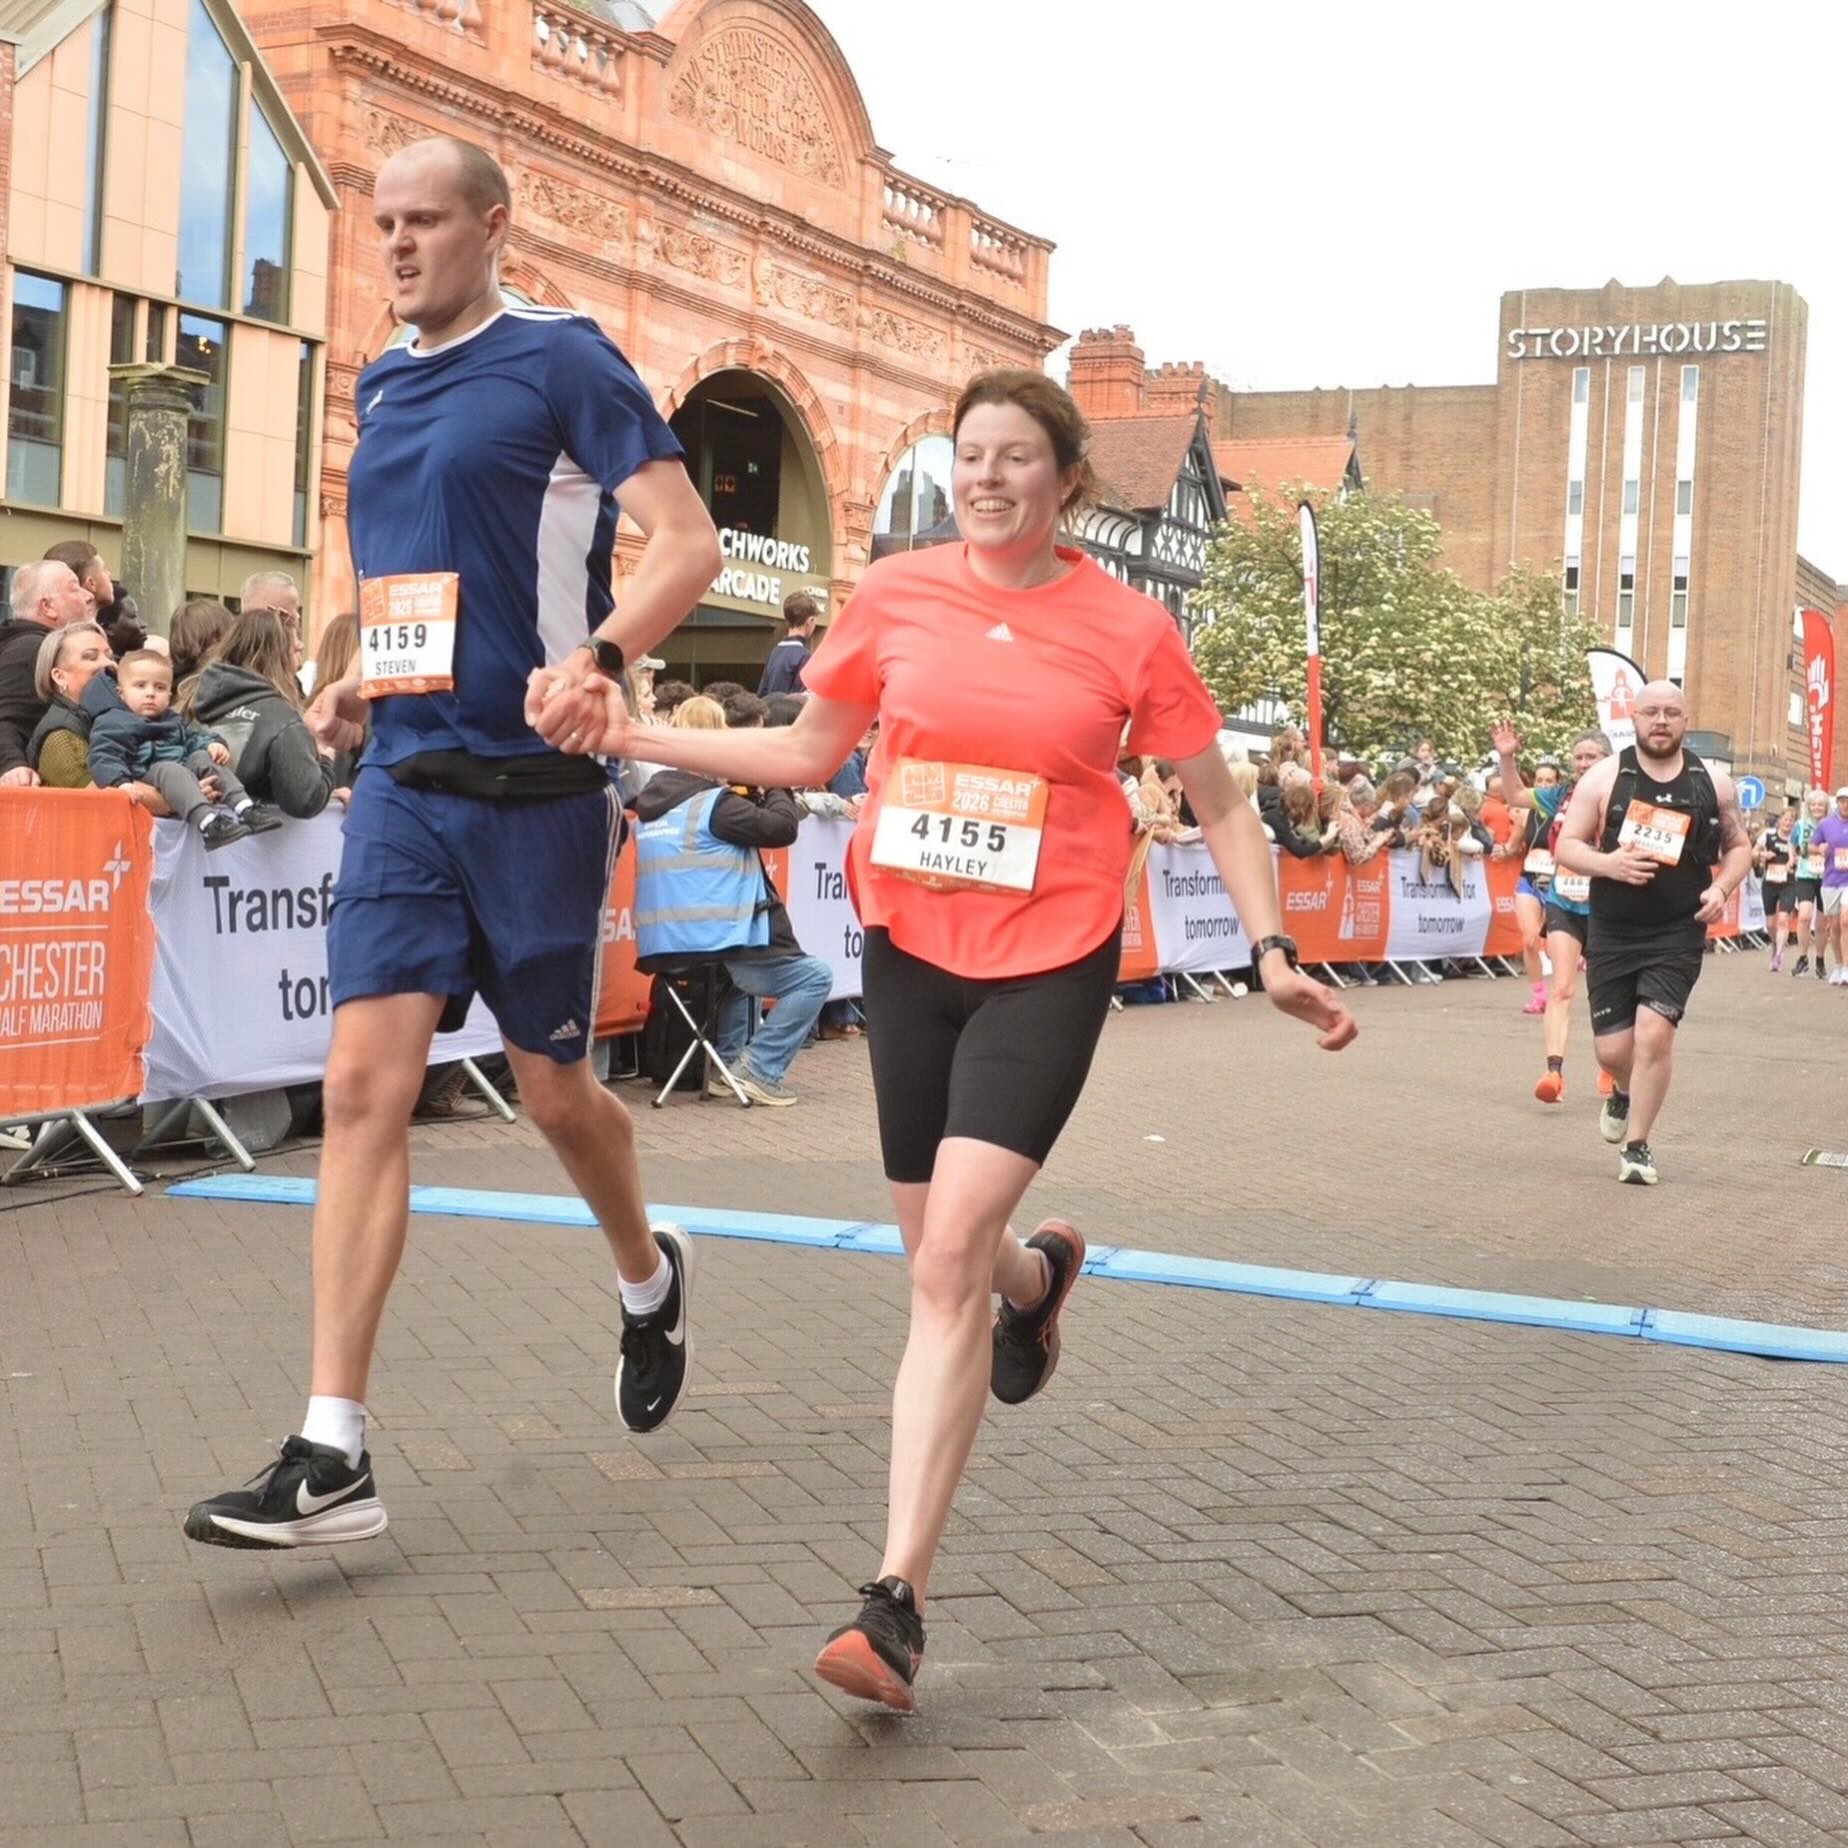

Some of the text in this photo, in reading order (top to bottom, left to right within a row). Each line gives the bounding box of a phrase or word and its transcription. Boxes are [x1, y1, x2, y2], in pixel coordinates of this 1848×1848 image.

[1507, 319, 1766, 358] STORYHOUSE
[369, 623, 427, 652] 4159
[375, 659, 417, 676] STEVEN
[954, 773, 1032, 797] ESSAR
[951, 790, 990, 813] 2026
[911, 813, 1007, 853] 4155
[1633, 823, 1673, 845] 2235
[920, 851, 989, 876] HAYLEY
[0, 879, 110, 913] ESSAR
[1285, 891, 1328, 911] ESSAR
[1184, 914, 1240, 940] tomorrow
[1418, 912, 1465, 933] tomorrow
[0, 940, 106, 1003] CHESTER
[0, 1000, 103, 1037] ALF MARATHON
